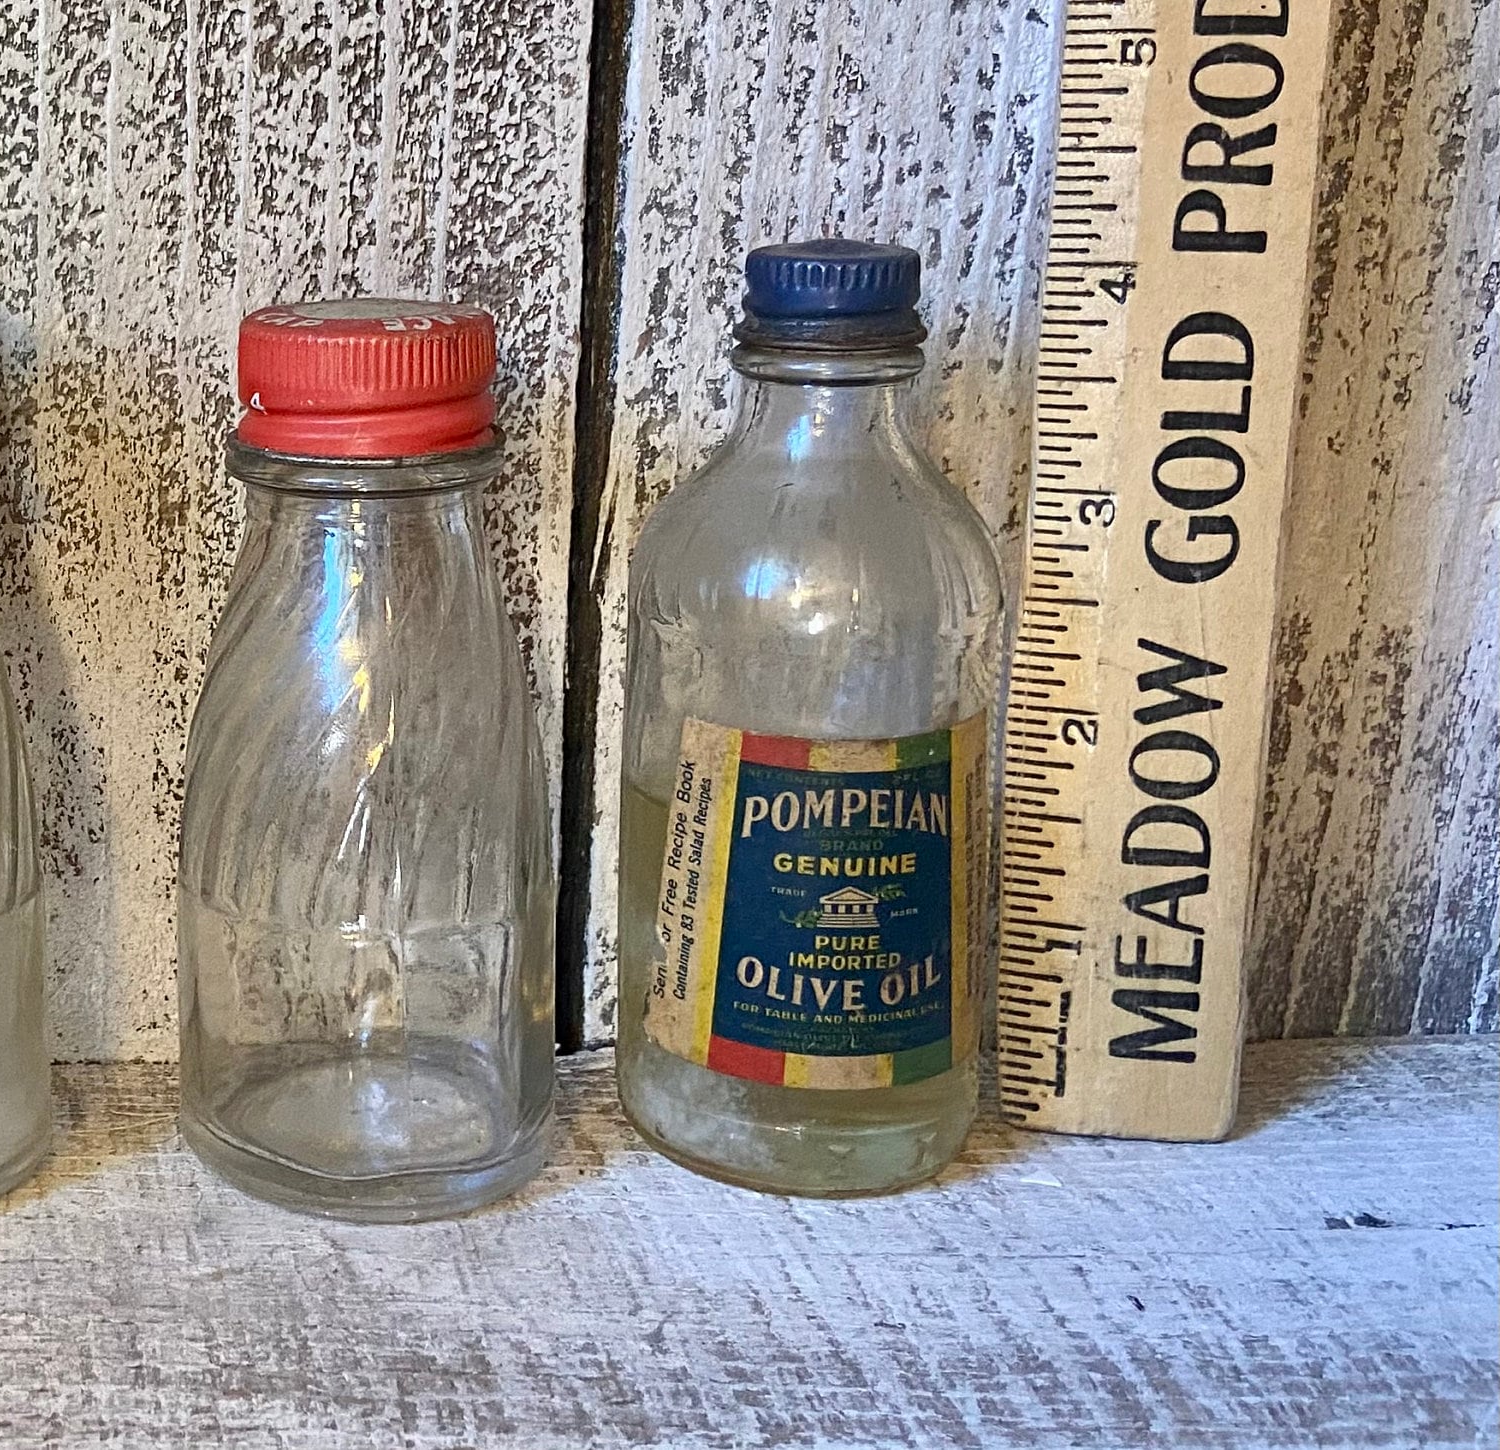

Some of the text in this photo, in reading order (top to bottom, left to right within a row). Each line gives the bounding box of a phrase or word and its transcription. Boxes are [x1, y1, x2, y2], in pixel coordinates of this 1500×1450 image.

[1120, 38, 1157, 68] 5
[1100, 271, 1137, 305] 4
[1144, 310, 1255, 585] GOLD
[1078, 498, 1116, 528] 3
[1061, 717, 1099, 747] 2
[676, 760, 697, 804] Book
[741, 788, 949, 839] POMPEIAN
[667, 812, 689, 871] Recipe
[1108, 637, 1228, 1064] MEADOW
[773, 852, 917, 877] GENUINE
[661, 878, 679, 917] Free
[672, 777, 713, 1000] Containing 83 Tested Salad Recipes
[814, 934, 881, 950] PURE
[788, 951, 901, 971] IMPORTED
[735, 955, 867, 1012] OLIVE
[879, 953, 942, 1006] OIL
[733, 1000, 760, 1013] FOR
[764, 1008, 807, 1022] TABLE
[813, 1014, 843, 1025] AND
